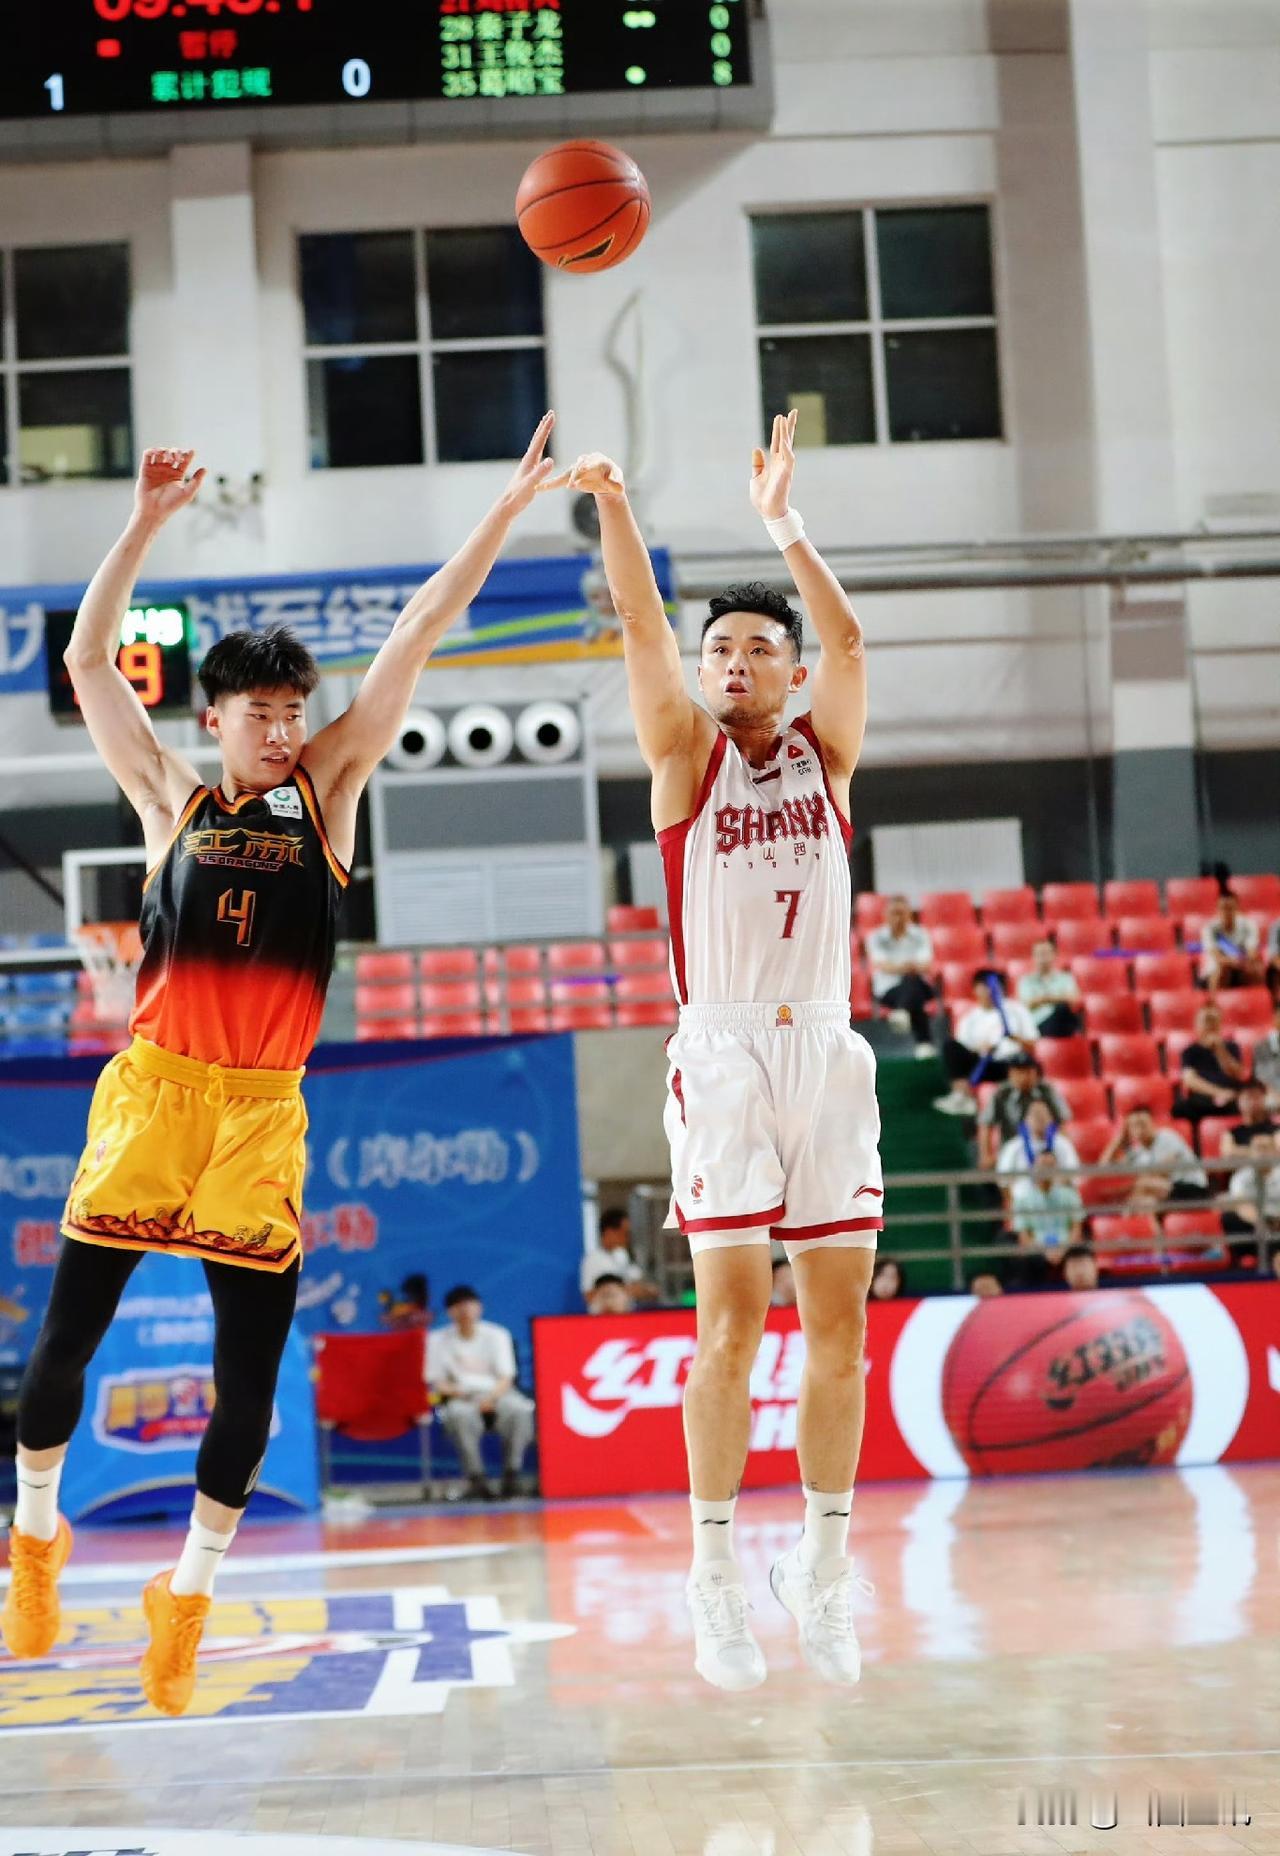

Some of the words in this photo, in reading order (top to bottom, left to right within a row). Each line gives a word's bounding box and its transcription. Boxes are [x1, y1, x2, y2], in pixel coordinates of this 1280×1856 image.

[44, 73, 64, 111] 1
[342, 58, 371, 97] 0
[217, 888, 256, 947] 4
[774, 889, 805, 939] 7
